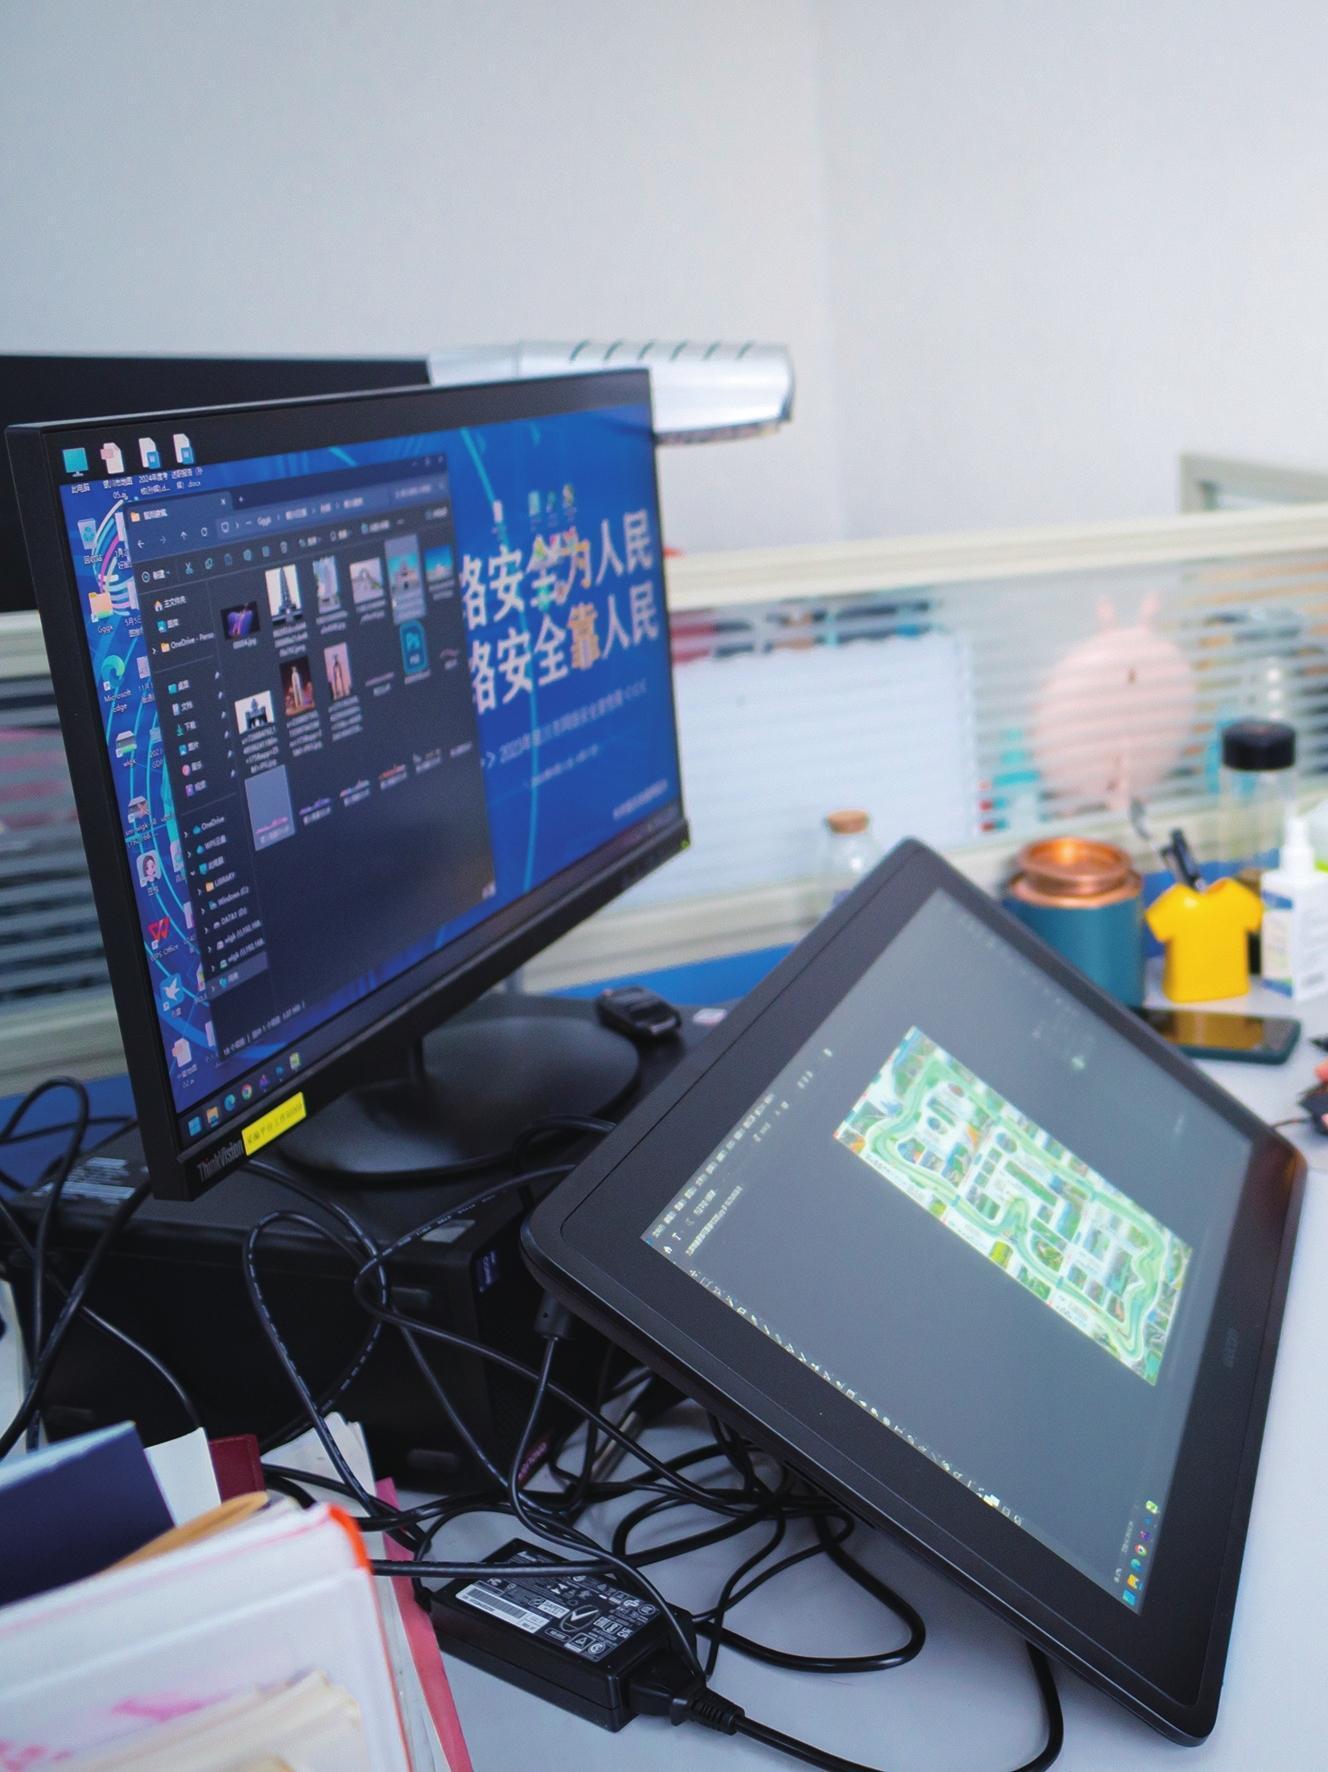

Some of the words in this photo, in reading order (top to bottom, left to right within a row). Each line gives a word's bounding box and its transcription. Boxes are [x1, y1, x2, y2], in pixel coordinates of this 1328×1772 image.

[71, 482, 91, 494] 此电脑
[104, 689, 132, 702] Microsoft
[201, 816, 225, 830] OneDrive
